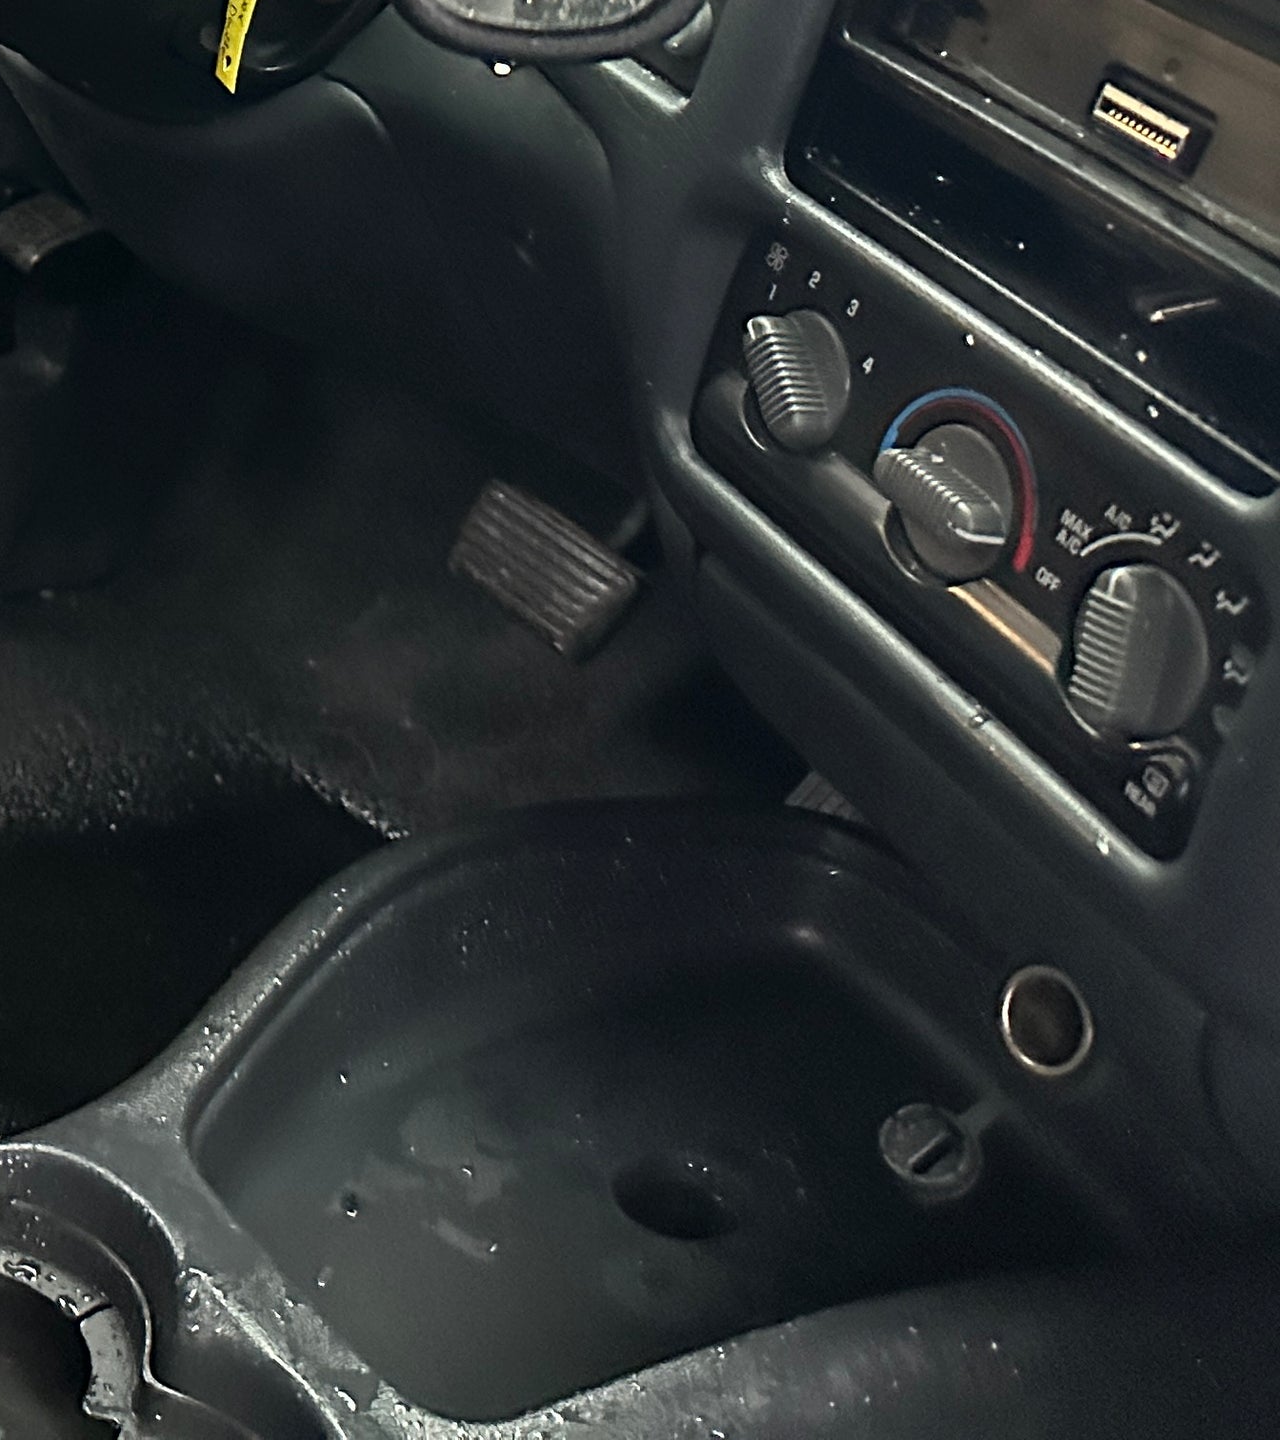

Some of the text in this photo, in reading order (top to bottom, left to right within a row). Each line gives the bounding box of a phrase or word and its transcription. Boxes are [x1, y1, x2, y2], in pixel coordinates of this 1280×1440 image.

[808, 270, 821, 289] 2
[846, 298, 860, 318] 3
[862, 356, 875, 375] 4
[1060, 508, 1094, 544] MAX
[1035, 566, 1061, 591] OFF
